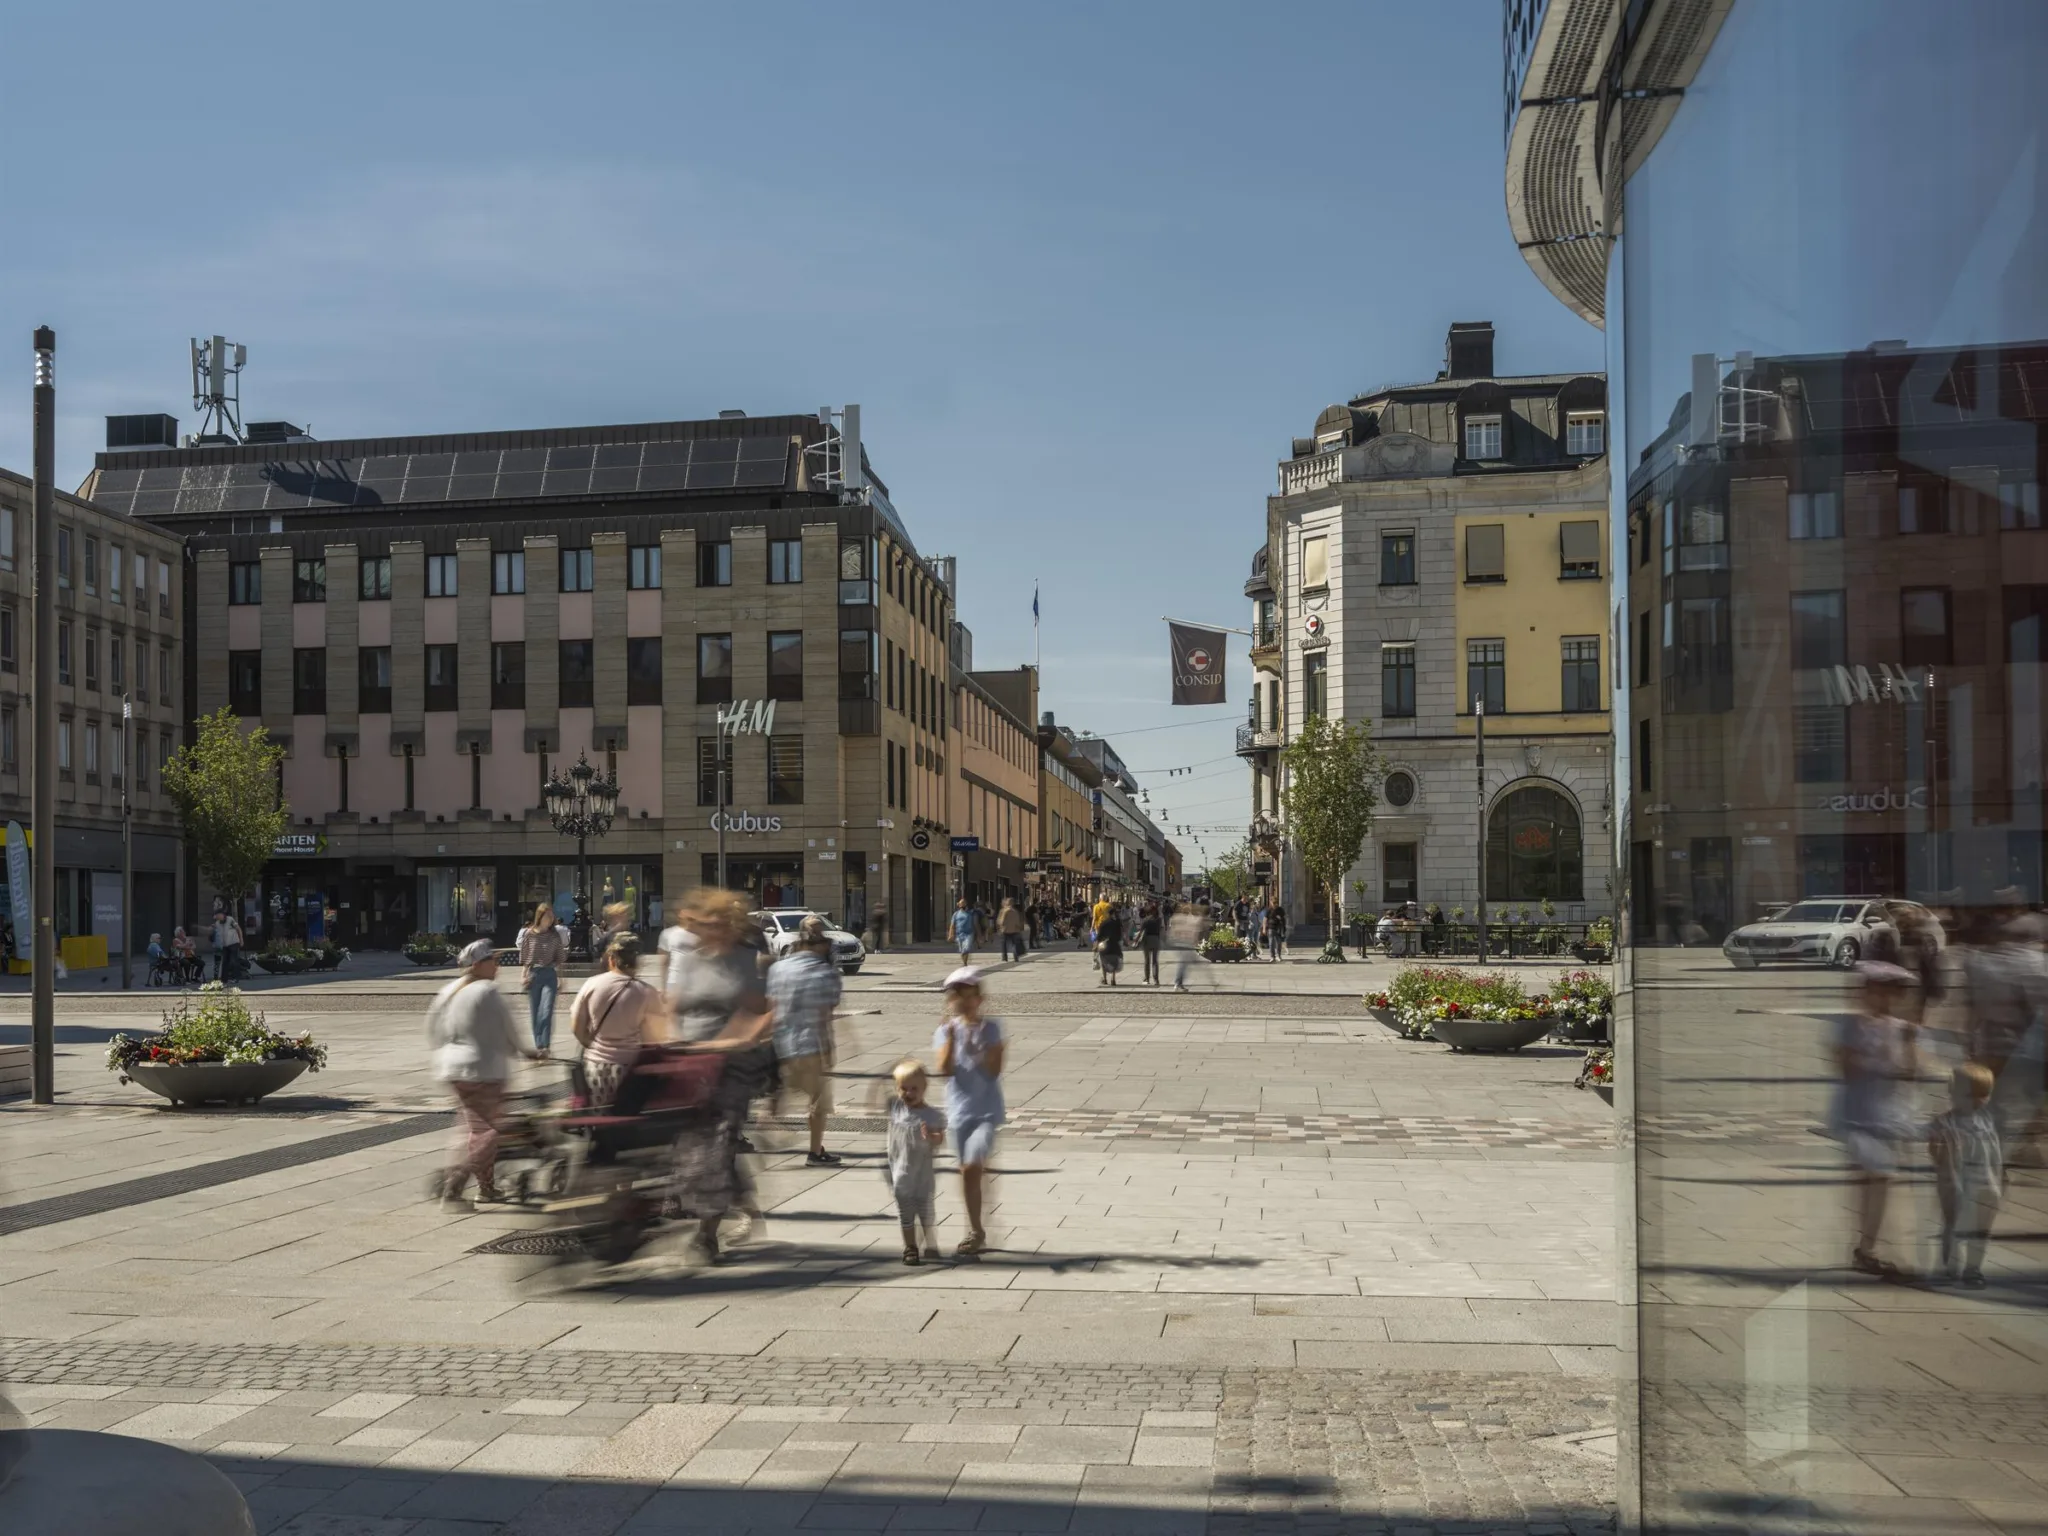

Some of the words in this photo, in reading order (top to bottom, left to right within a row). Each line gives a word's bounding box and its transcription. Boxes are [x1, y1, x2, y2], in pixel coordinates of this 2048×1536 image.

[1175, 673, 1222, 686] CONSID
[722, 698, 777, 737] H&M
[710, 809, 781, 833] Cubus
